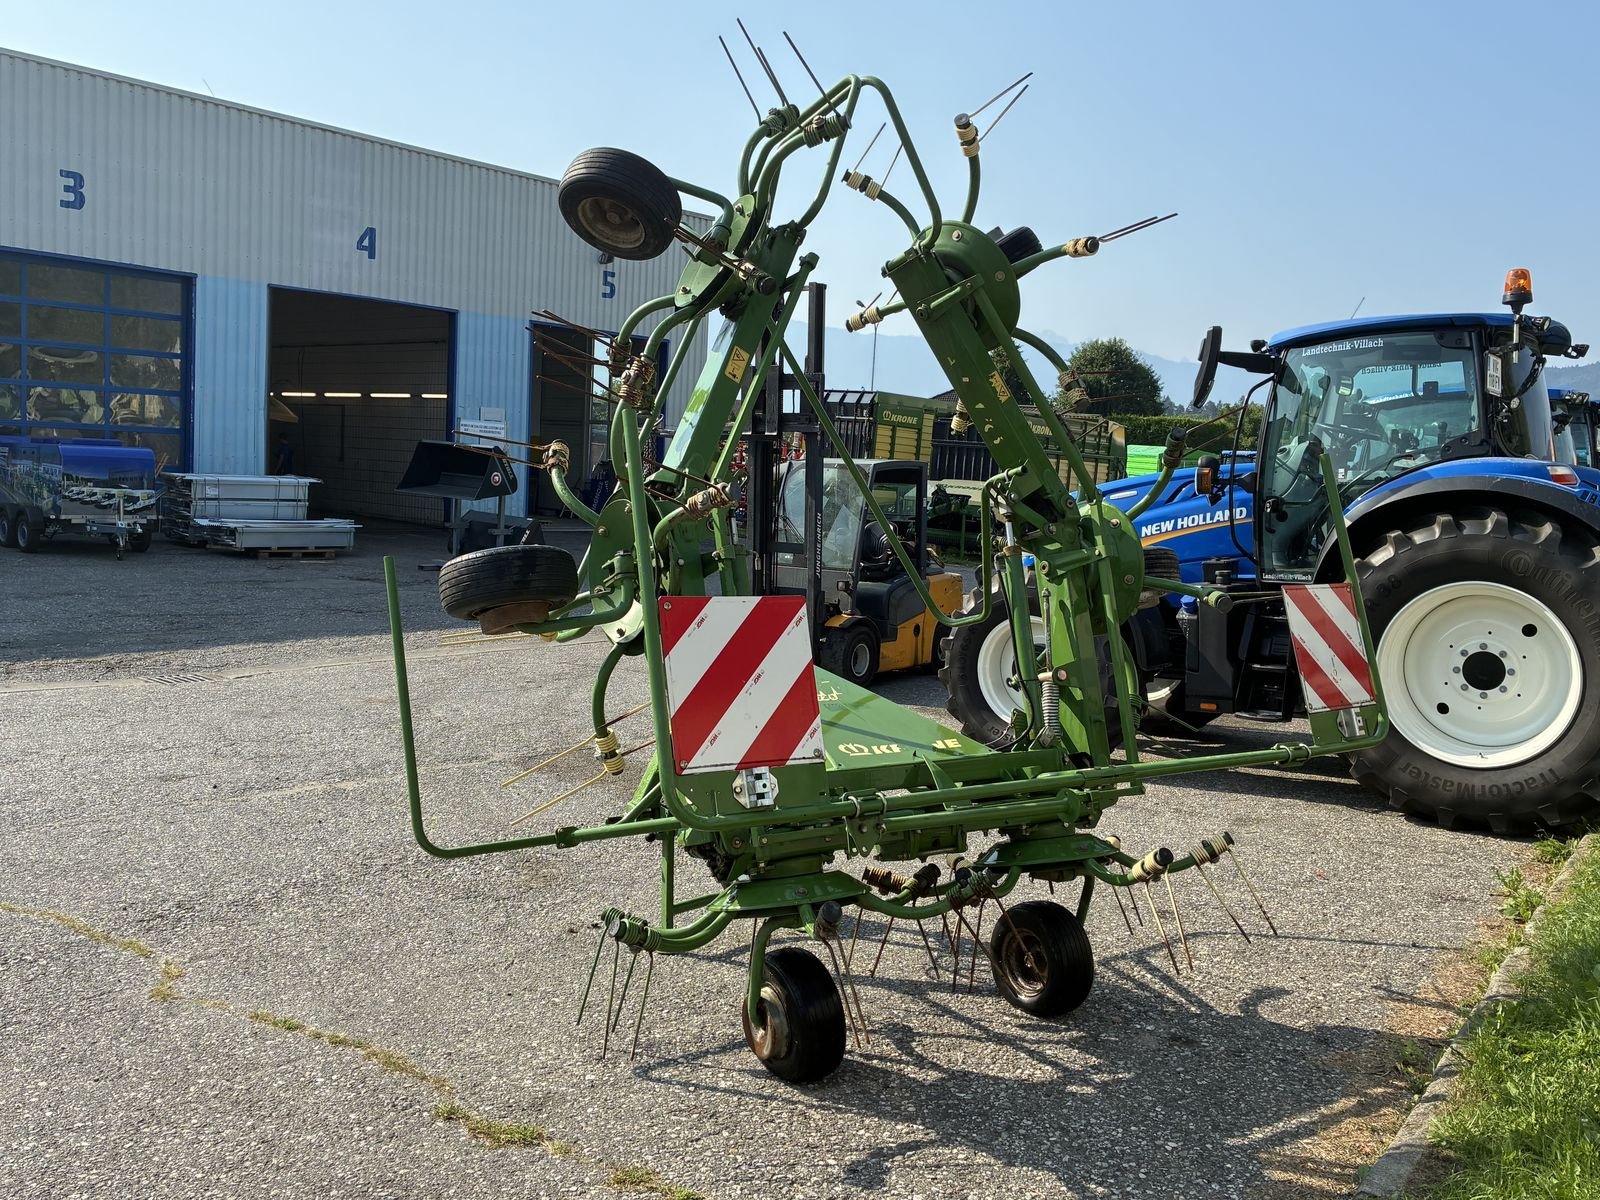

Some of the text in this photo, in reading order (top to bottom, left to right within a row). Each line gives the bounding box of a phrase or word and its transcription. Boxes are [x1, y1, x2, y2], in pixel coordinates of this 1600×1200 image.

[59, 169, 86, 210] 3
[356, 226, 377, 260] 4
[601, 270, 616, 299] 5
[1302, 338, 1384, 357] Landtechnik-Villach
[890, 413, 918, 425] KRONE
[1032, 424, 1053, 436] KRON
[1141, 506, 1248, 538] NEW HOLLAND
[1400, 762, 1568, 800] TractorMaster
